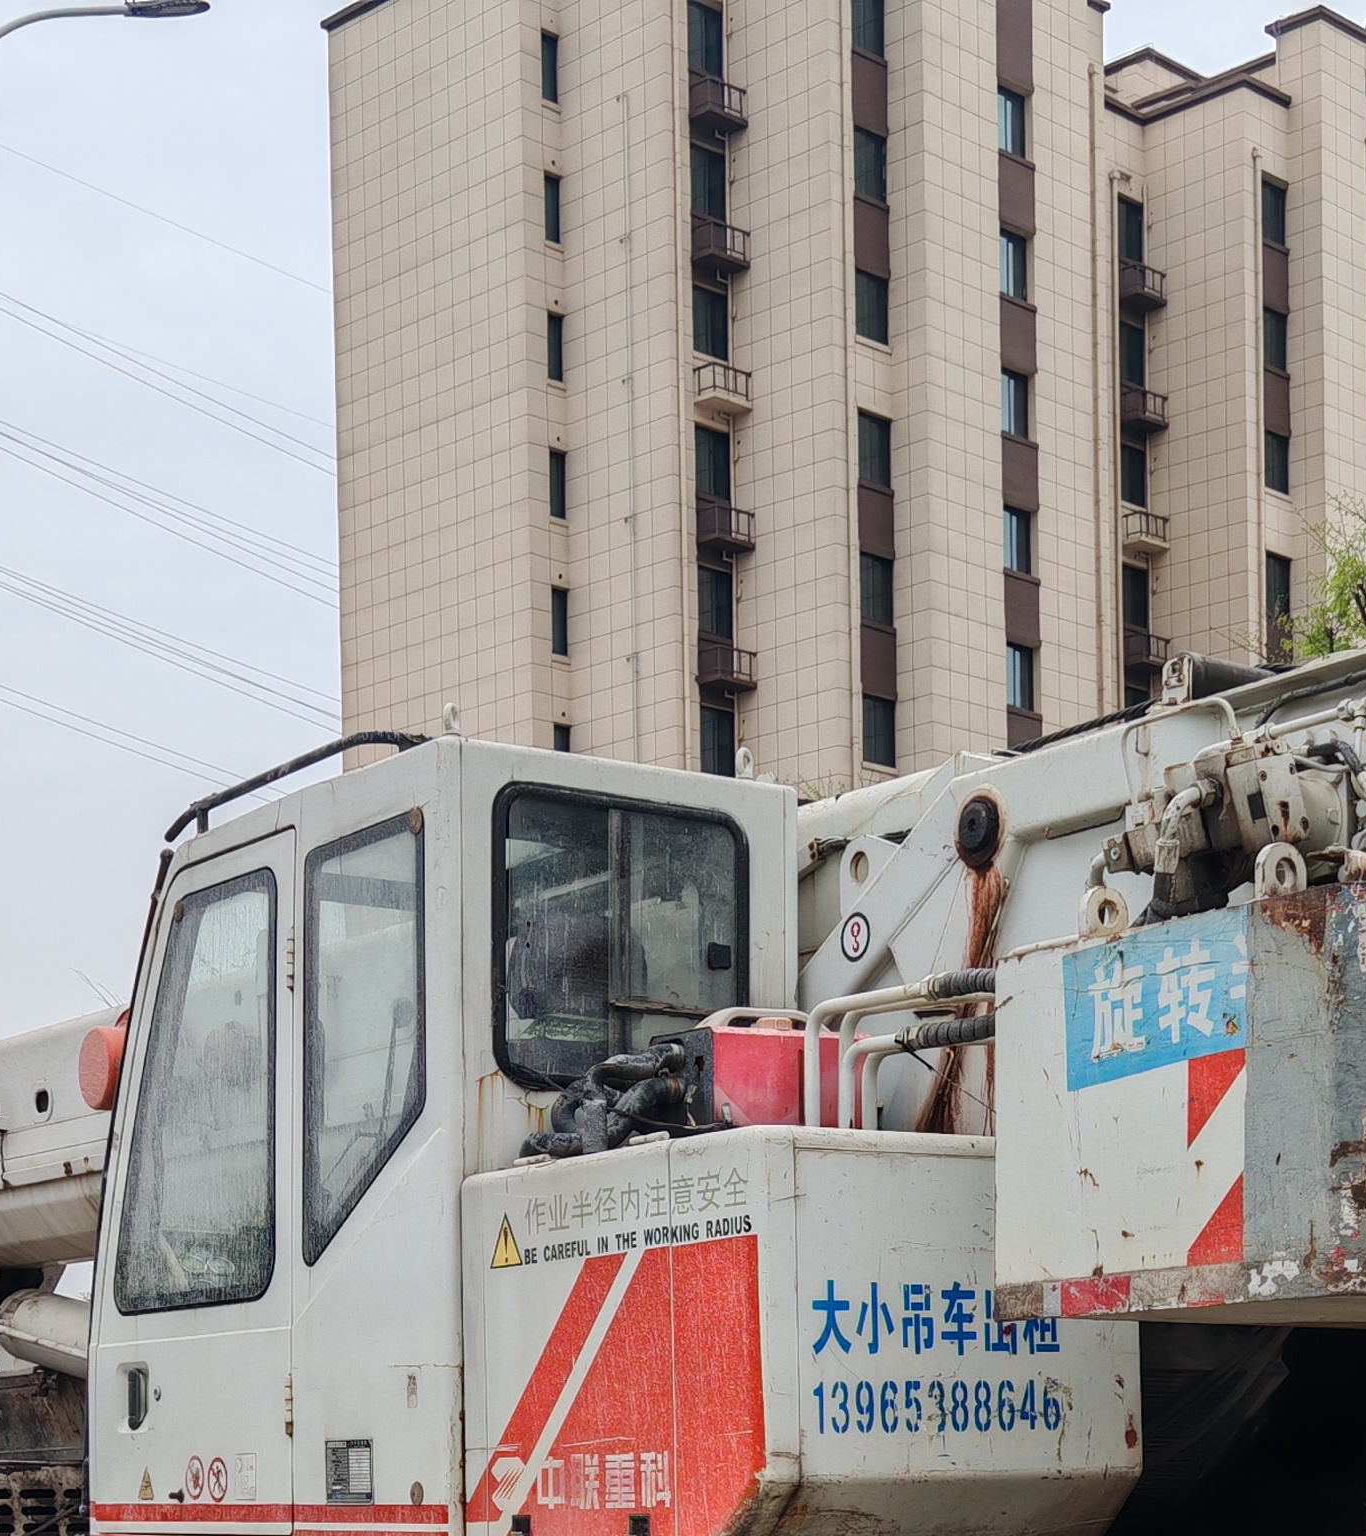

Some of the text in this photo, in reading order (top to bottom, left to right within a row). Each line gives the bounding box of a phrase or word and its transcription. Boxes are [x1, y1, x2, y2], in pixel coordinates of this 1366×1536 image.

[524, 1167, 748, 1235] 作业半径内注意安全
[524, 1214, 752, 1265] BE CAREFUL IN THE WORKING RADIUS
[812, 1378, 1061, 1435] 13965388646
[536, 1450, 672, 1510] 中联重科
